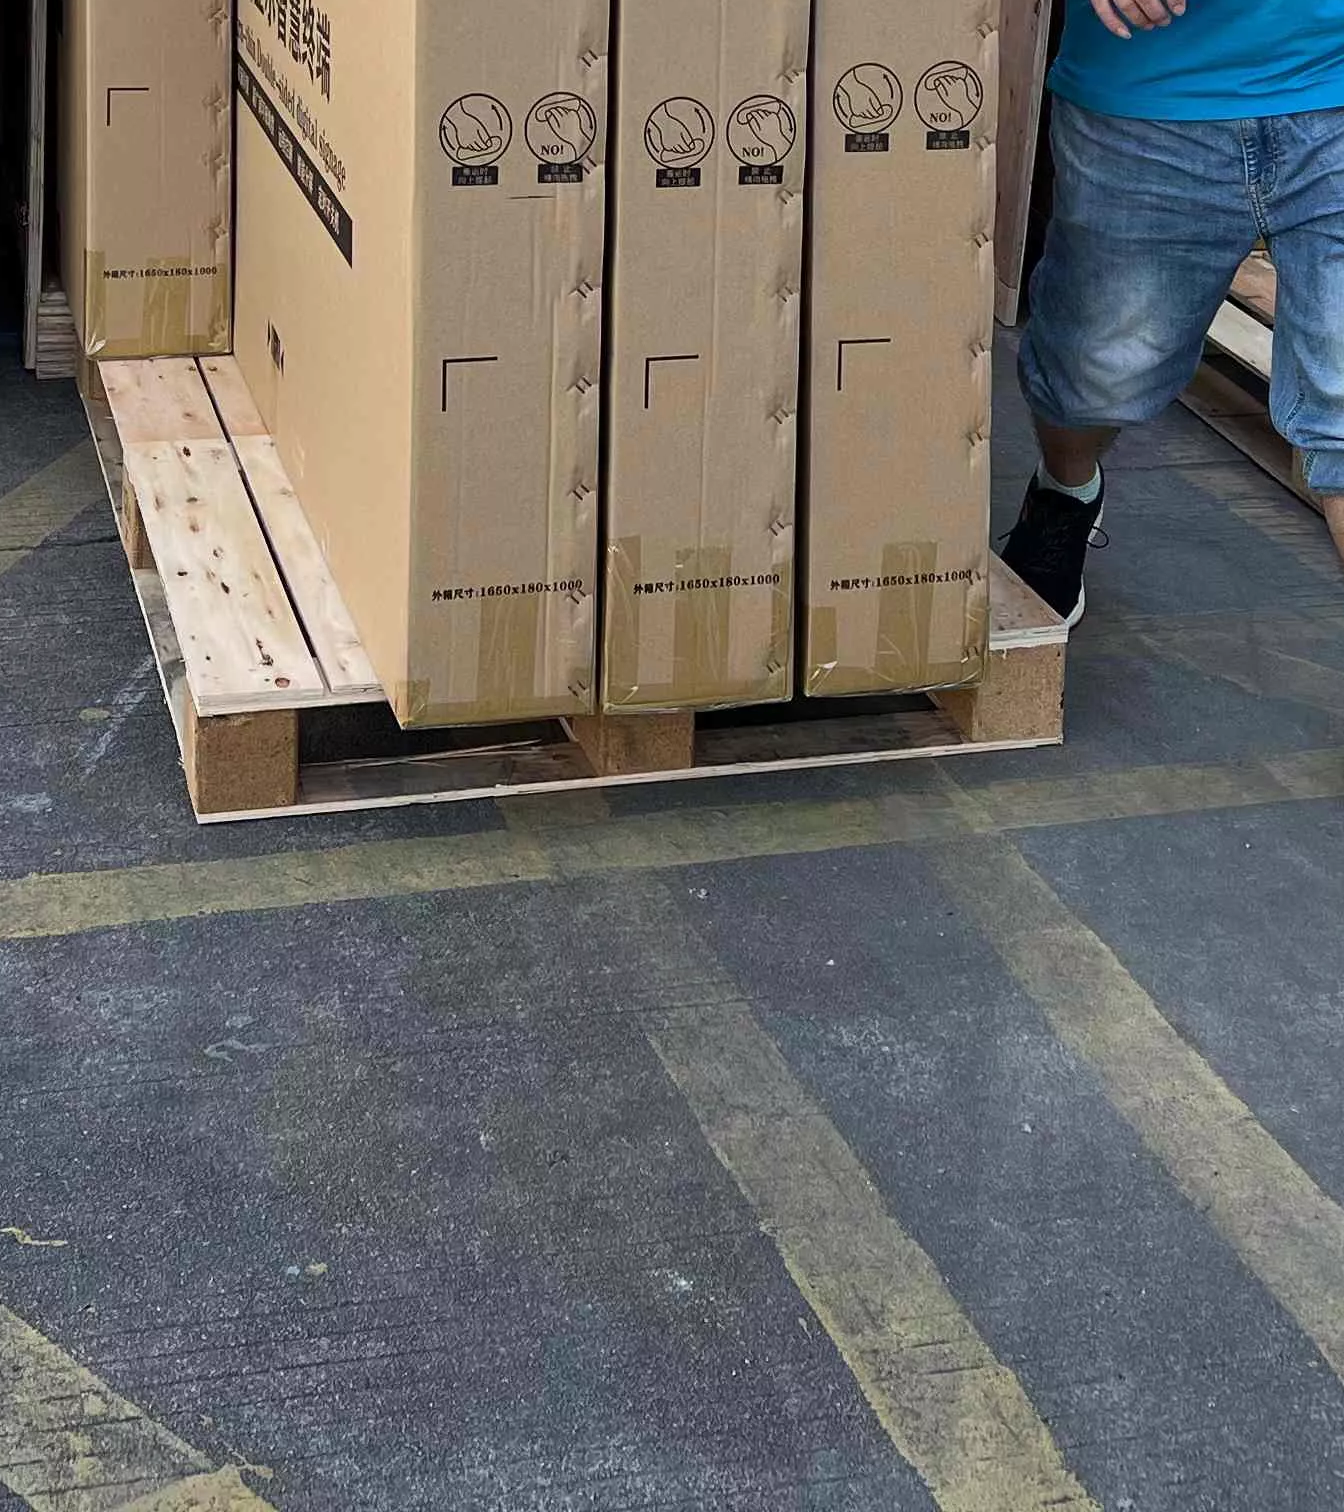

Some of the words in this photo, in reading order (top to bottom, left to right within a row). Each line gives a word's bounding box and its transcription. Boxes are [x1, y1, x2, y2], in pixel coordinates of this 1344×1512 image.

[930, 112, 951, 123] NO!
[540, 144, 564, 156] NO!
[742, 146, 764, 157] NO!
[319, 134, 346, 192] signage
